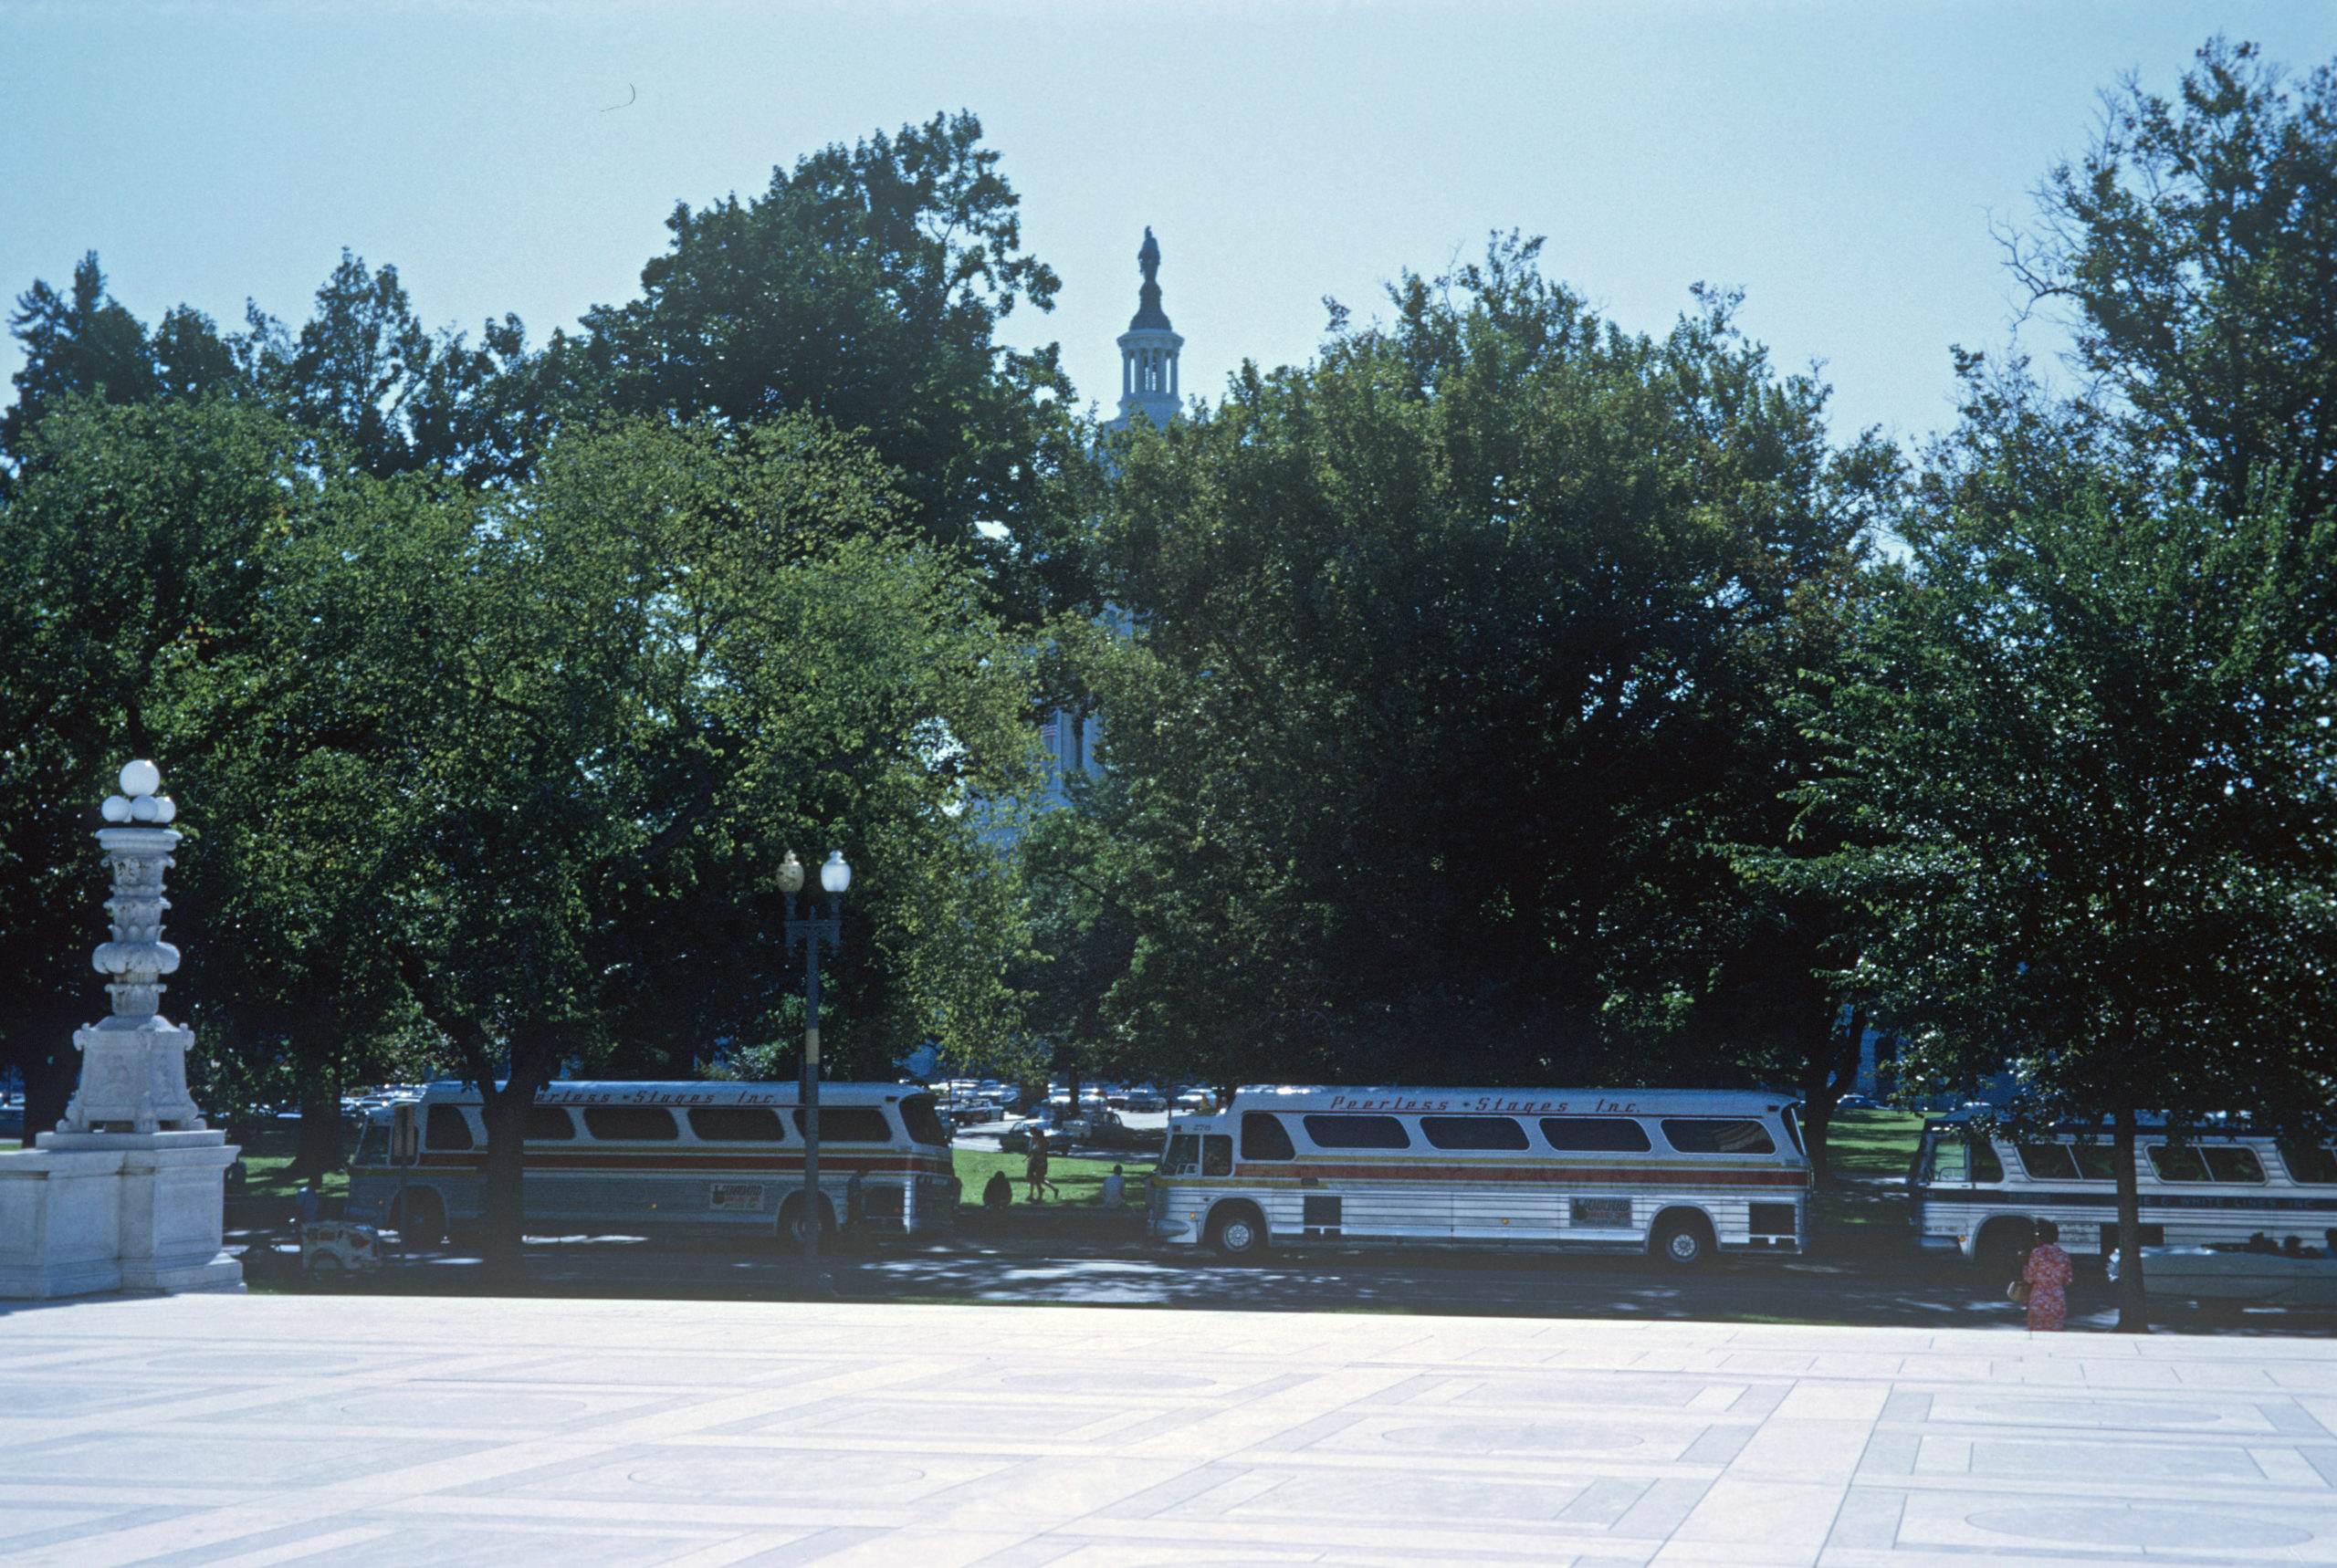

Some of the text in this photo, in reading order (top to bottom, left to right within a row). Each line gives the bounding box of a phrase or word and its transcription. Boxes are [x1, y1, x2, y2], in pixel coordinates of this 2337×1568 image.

[534, 1091, 611, 1103] erless
[633, 1091, 715, 1105] Stages
[1330, 1096, 1640, 1113] Peerless Stages Inc.
[2180, 1197, 2227, 1207] WHITE
[2234, 1197, 2278, 1208] LINES
